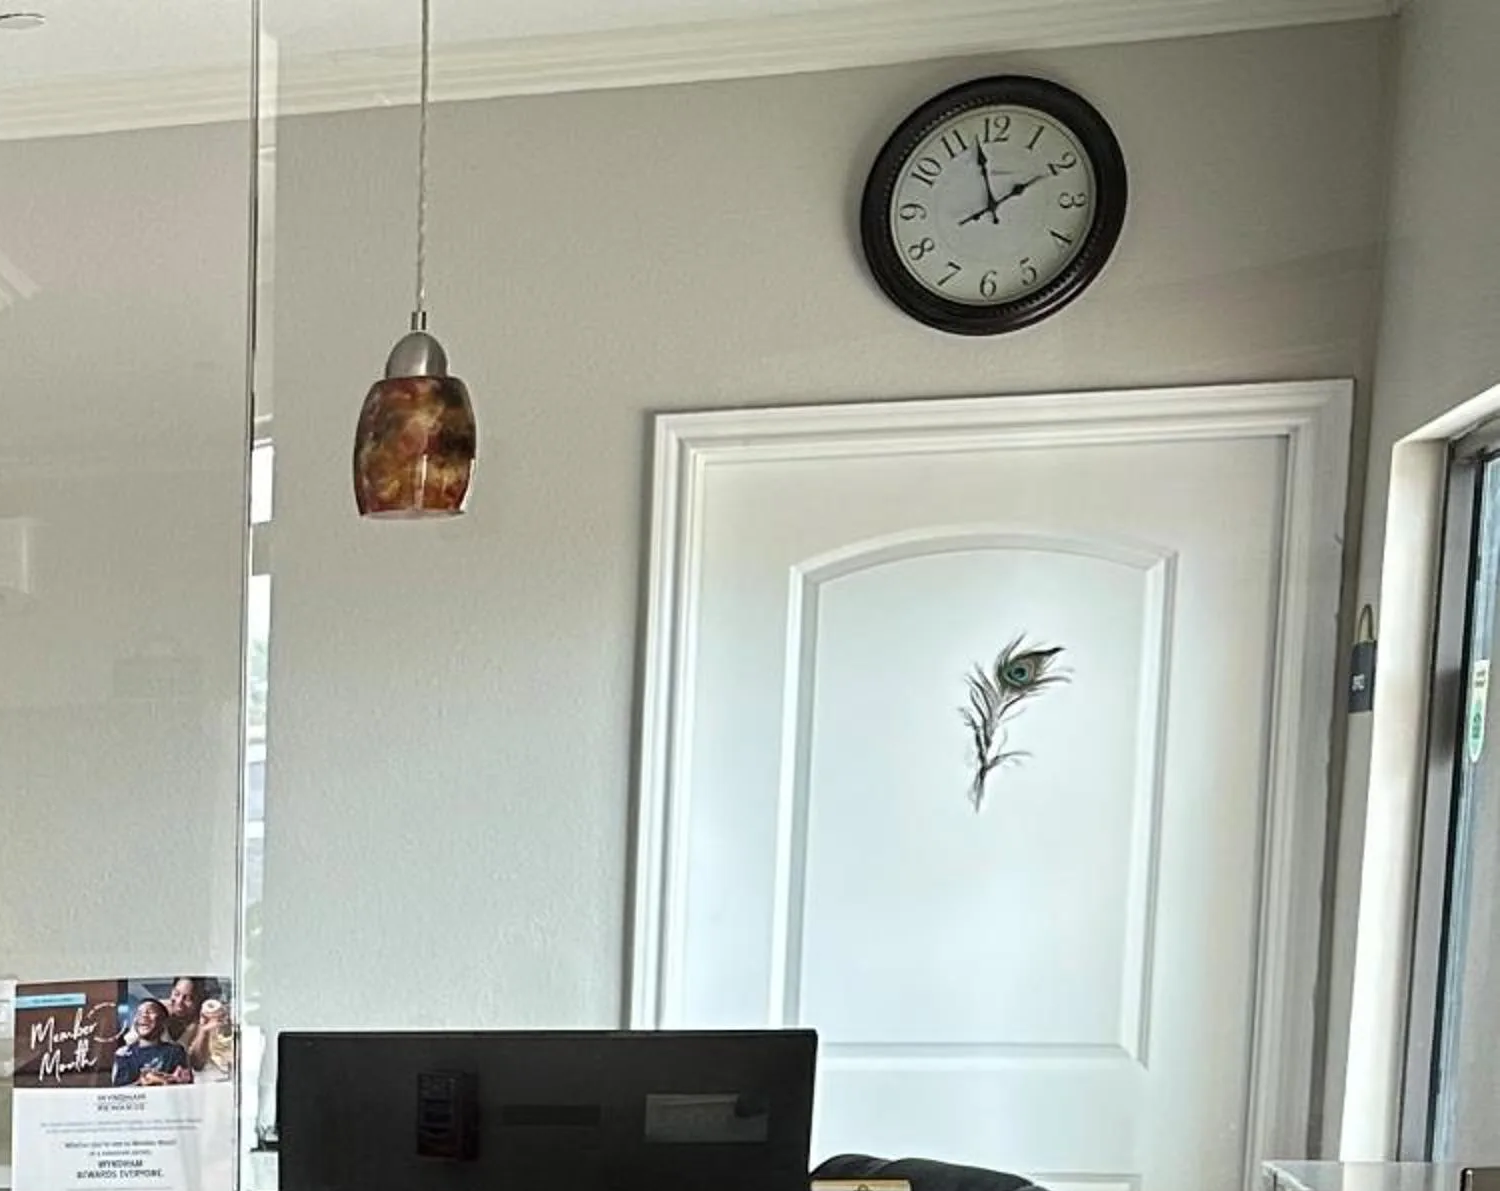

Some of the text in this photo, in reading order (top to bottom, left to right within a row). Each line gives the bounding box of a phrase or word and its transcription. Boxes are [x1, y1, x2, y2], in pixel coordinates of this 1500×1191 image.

[983, 115, 1011, 143] 12
[1025, 124, 1045, 150] 1
[940, 129, 968, 159] 11
[911, 155, 943, 187] 10
[1048, 151, 1077, 176] 2
[899, 202, 927, 221] 9
[1058, 191, 1088, 210] 3
[907, 236, 935, 261] 8
[936, 260, 962, 287] 7
[979, 269, 998, 298] 6
[1019, 256, 1037, 286] 5
[30, 1007, 99, 1053] Member
[38, 1038, 98, 1083] Month
